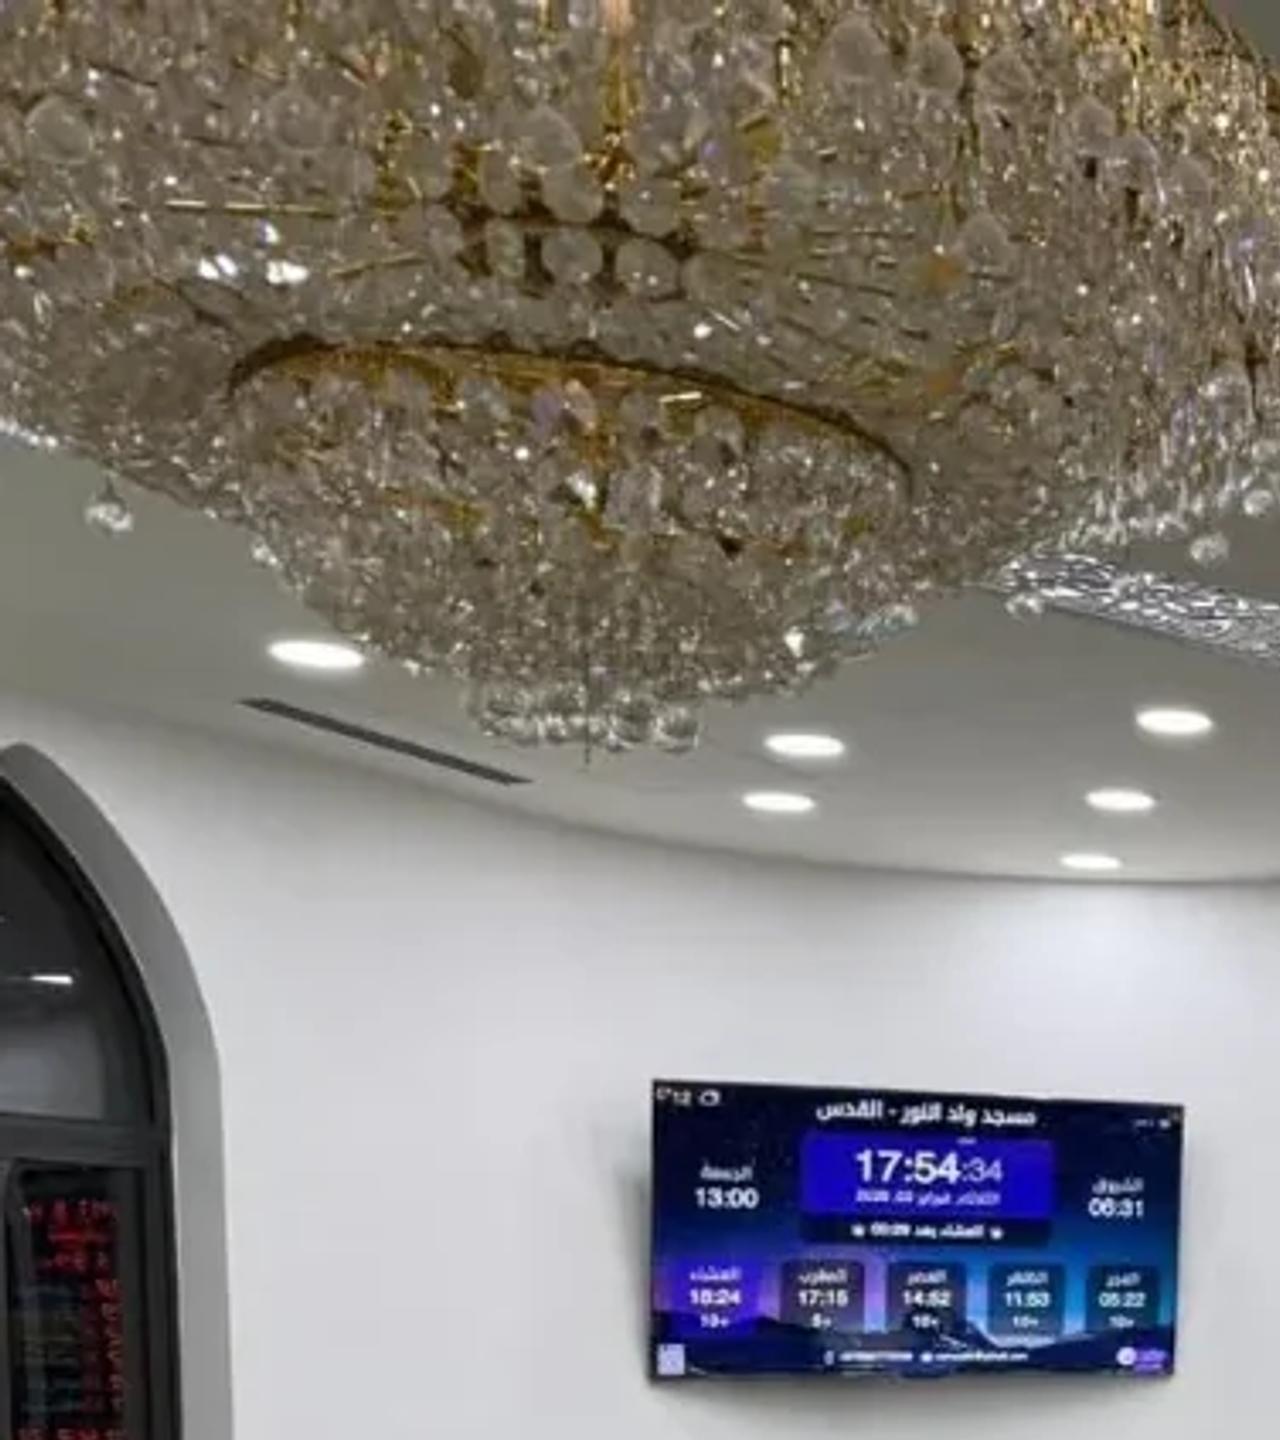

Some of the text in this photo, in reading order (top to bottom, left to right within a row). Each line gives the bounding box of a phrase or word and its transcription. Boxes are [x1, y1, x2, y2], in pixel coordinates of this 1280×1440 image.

[816, 1100, 883, 1121] القدس
[982, 1108, 1037, 1127] مسجد
[695, 1187, 760, 1209] 13:00
